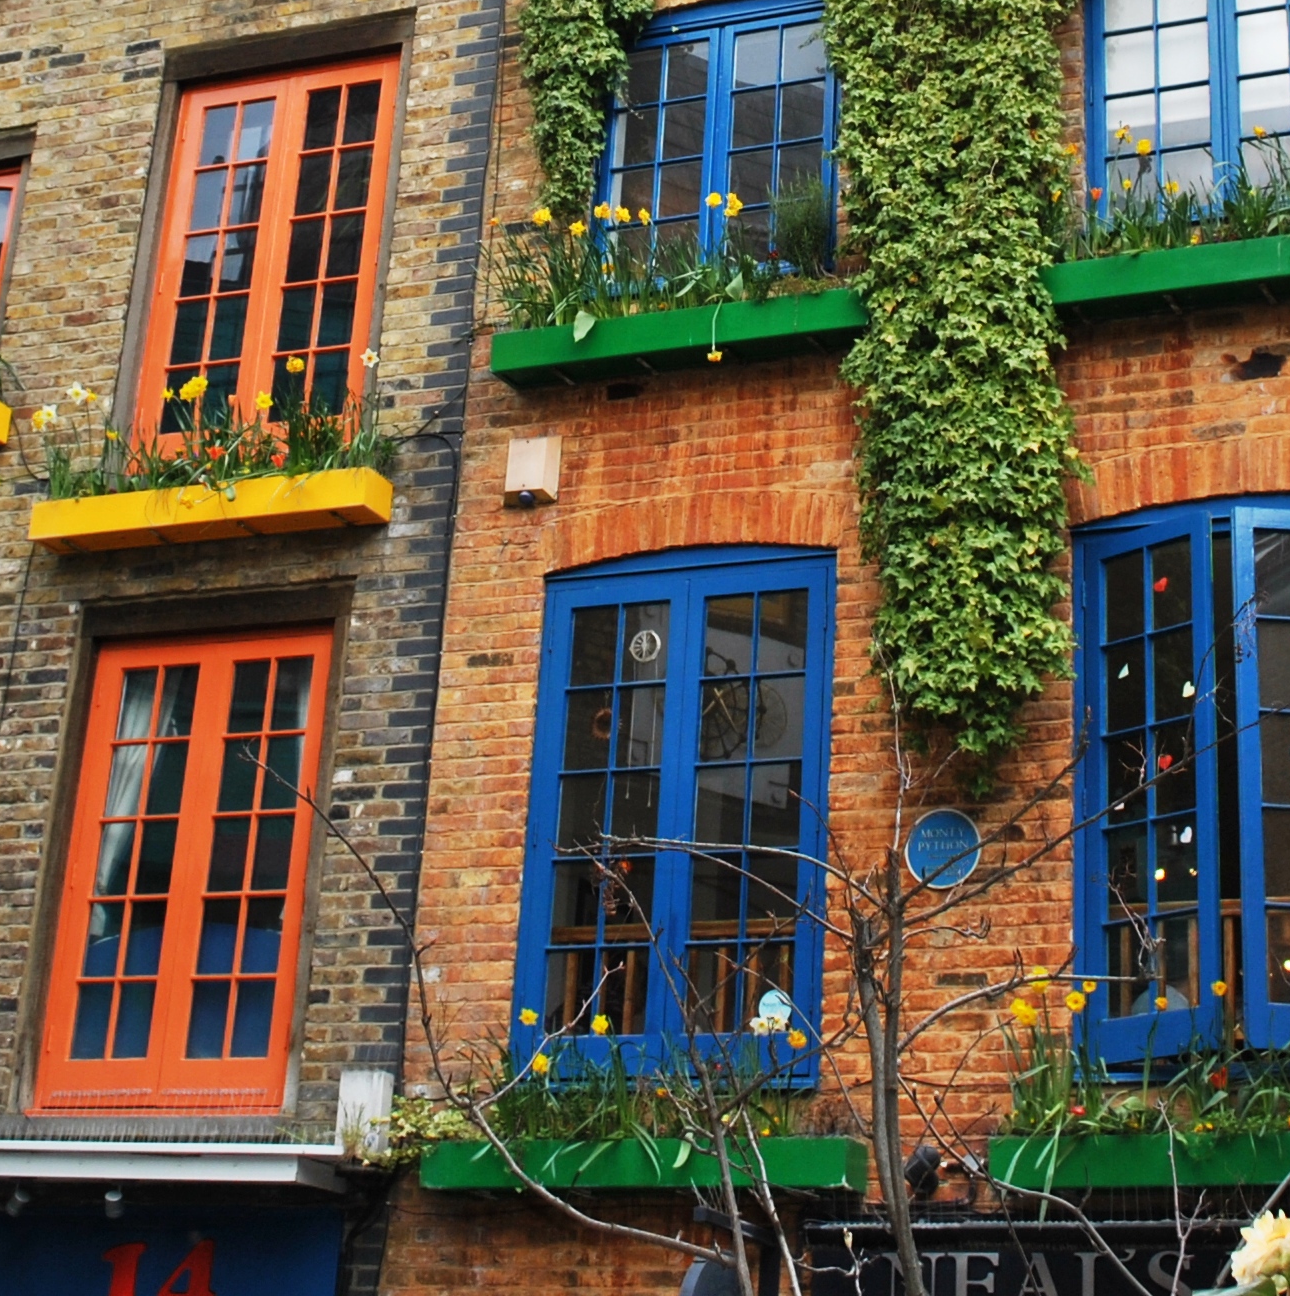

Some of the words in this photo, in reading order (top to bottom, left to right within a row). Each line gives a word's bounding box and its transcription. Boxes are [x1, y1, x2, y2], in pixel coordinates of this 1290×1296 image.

[921, 827, 964, 838] MONTY
[918, 840, 969, 852] PYTHON
[103, 1238, 217, 1296] 14
